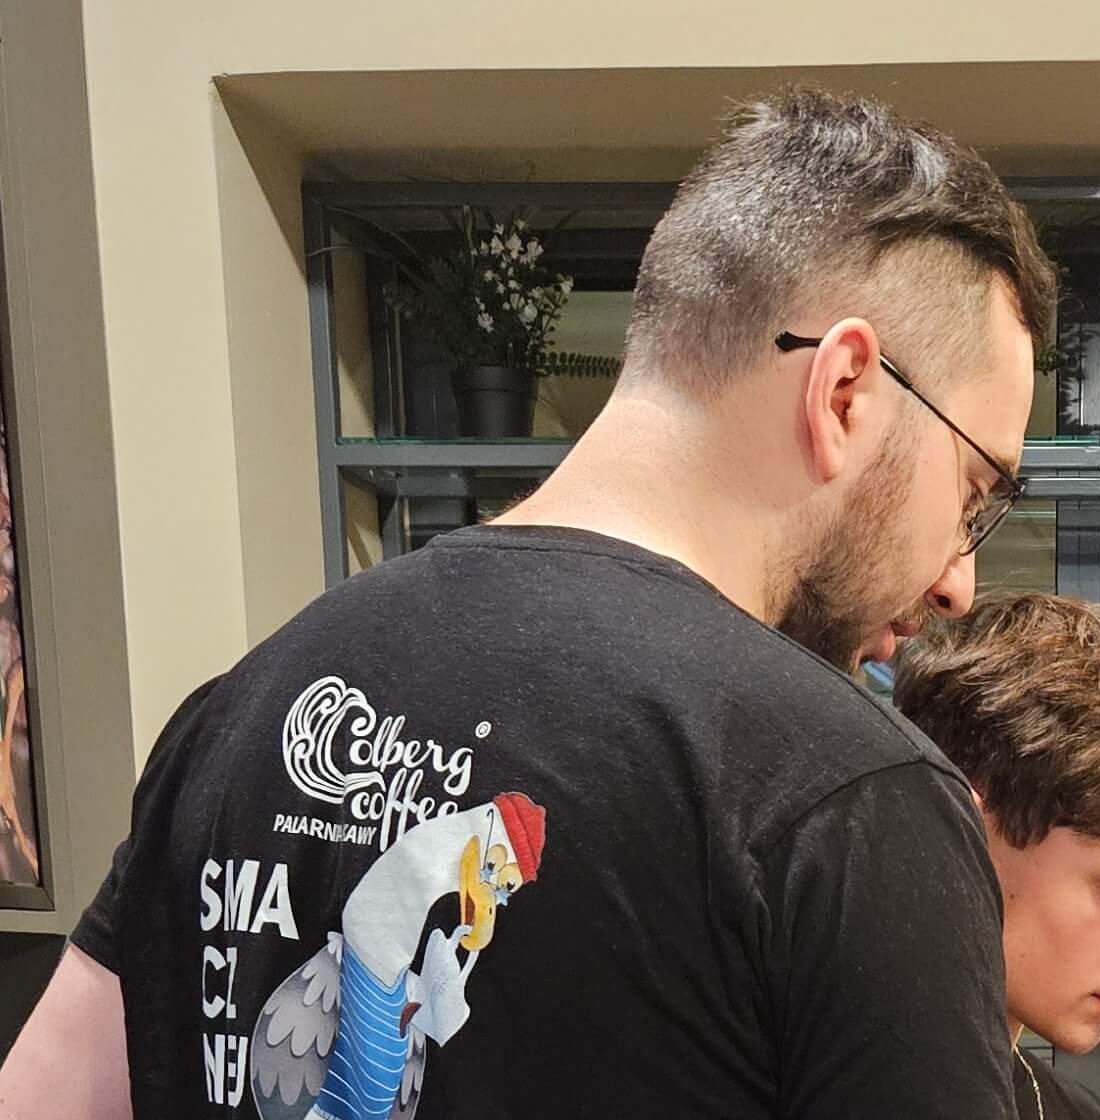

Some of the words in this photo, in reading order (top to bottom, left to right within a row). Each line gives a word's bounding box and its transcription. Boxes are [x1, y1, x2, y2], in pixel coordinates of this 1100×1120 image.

[273, 813, 342, 843] PALARN
[351, 767, 459, 852] coffee
[200, 857, 300, 940] SMA
